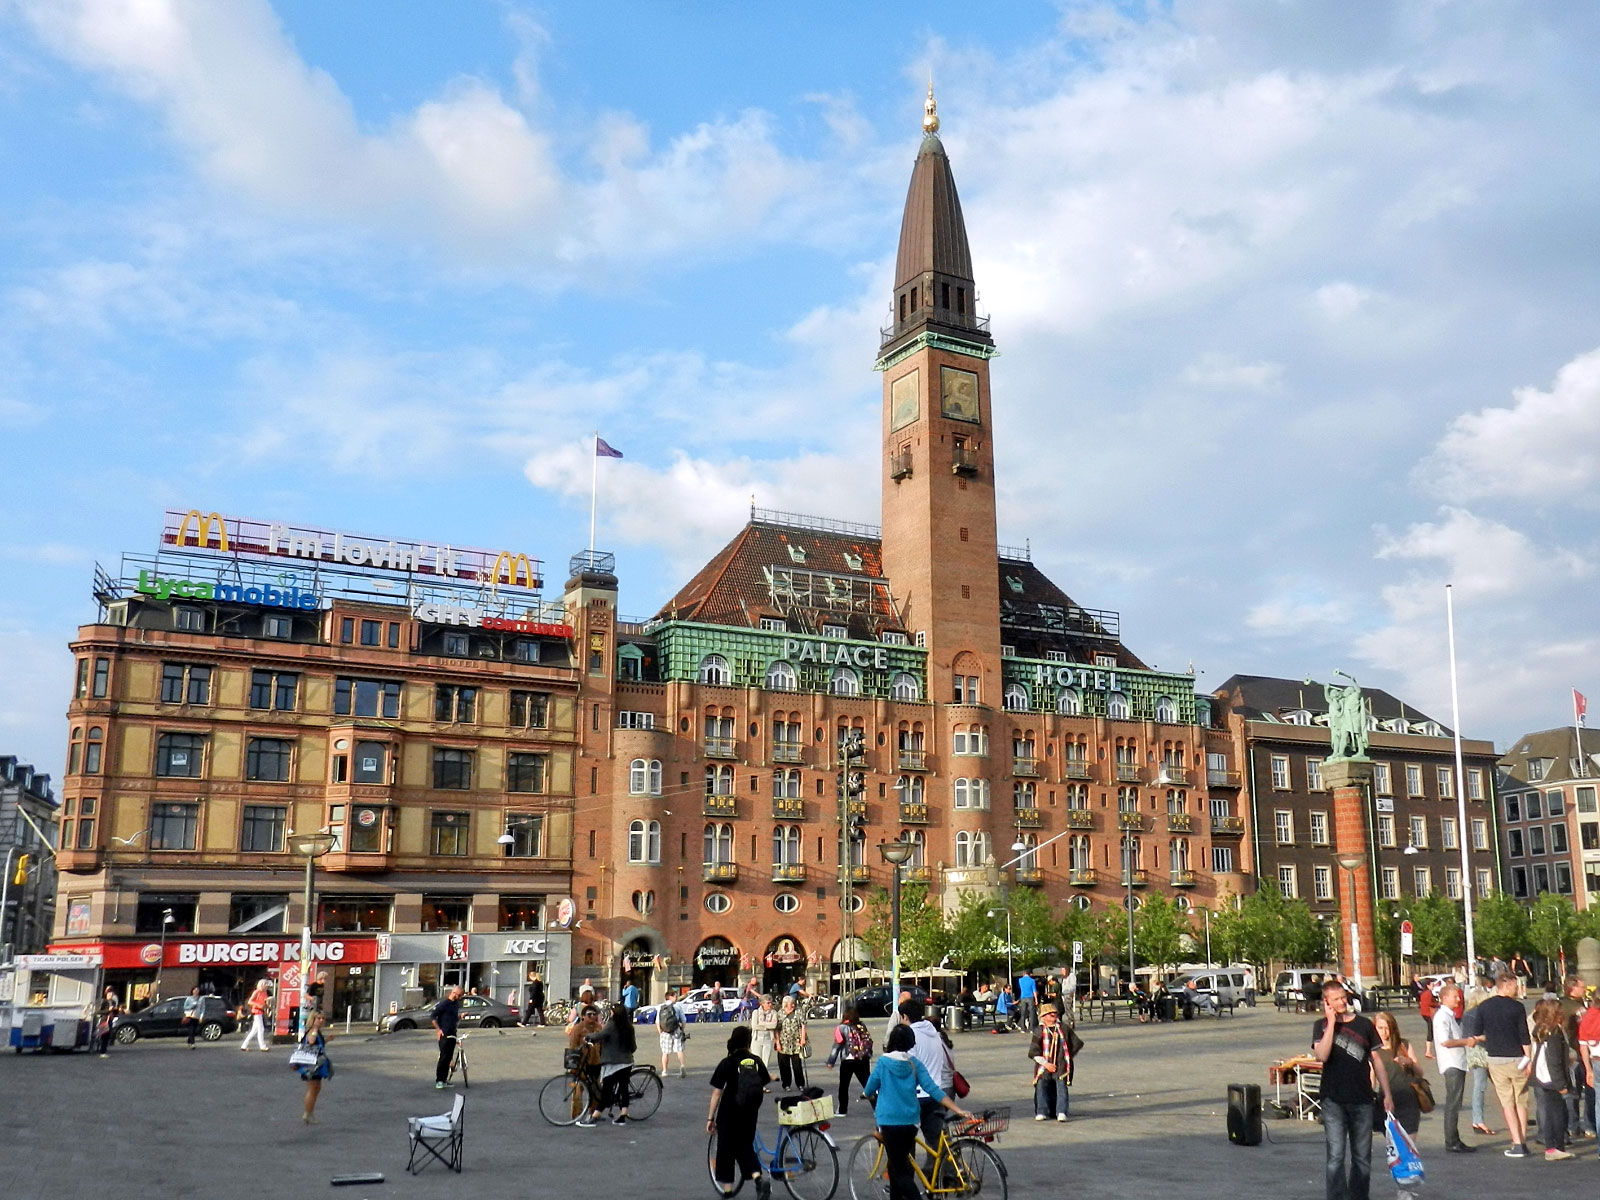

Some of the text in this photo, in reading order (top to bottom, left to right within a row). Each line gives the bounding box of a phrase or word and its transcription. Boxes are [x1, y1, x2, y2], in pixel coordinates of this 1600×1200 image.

[269, 523, 463, 577] i'm lovin' it
[137, 569, 318, 611] Lycamobile
[419, 602, 485, 628] CITY
[439, 658, 479, 669] HOTEL
[783, 637, 1123, 693] PALACE HOTEL
[179, 941, 345, 964] BURGER KNG
[503, 938, 549, 955] KFC
[699, 946, 729, 956] Believe
[282, 964, 300, 982] CPH
[349, 966, 362, 975] 55
[629, 960, 655, 968] useum
